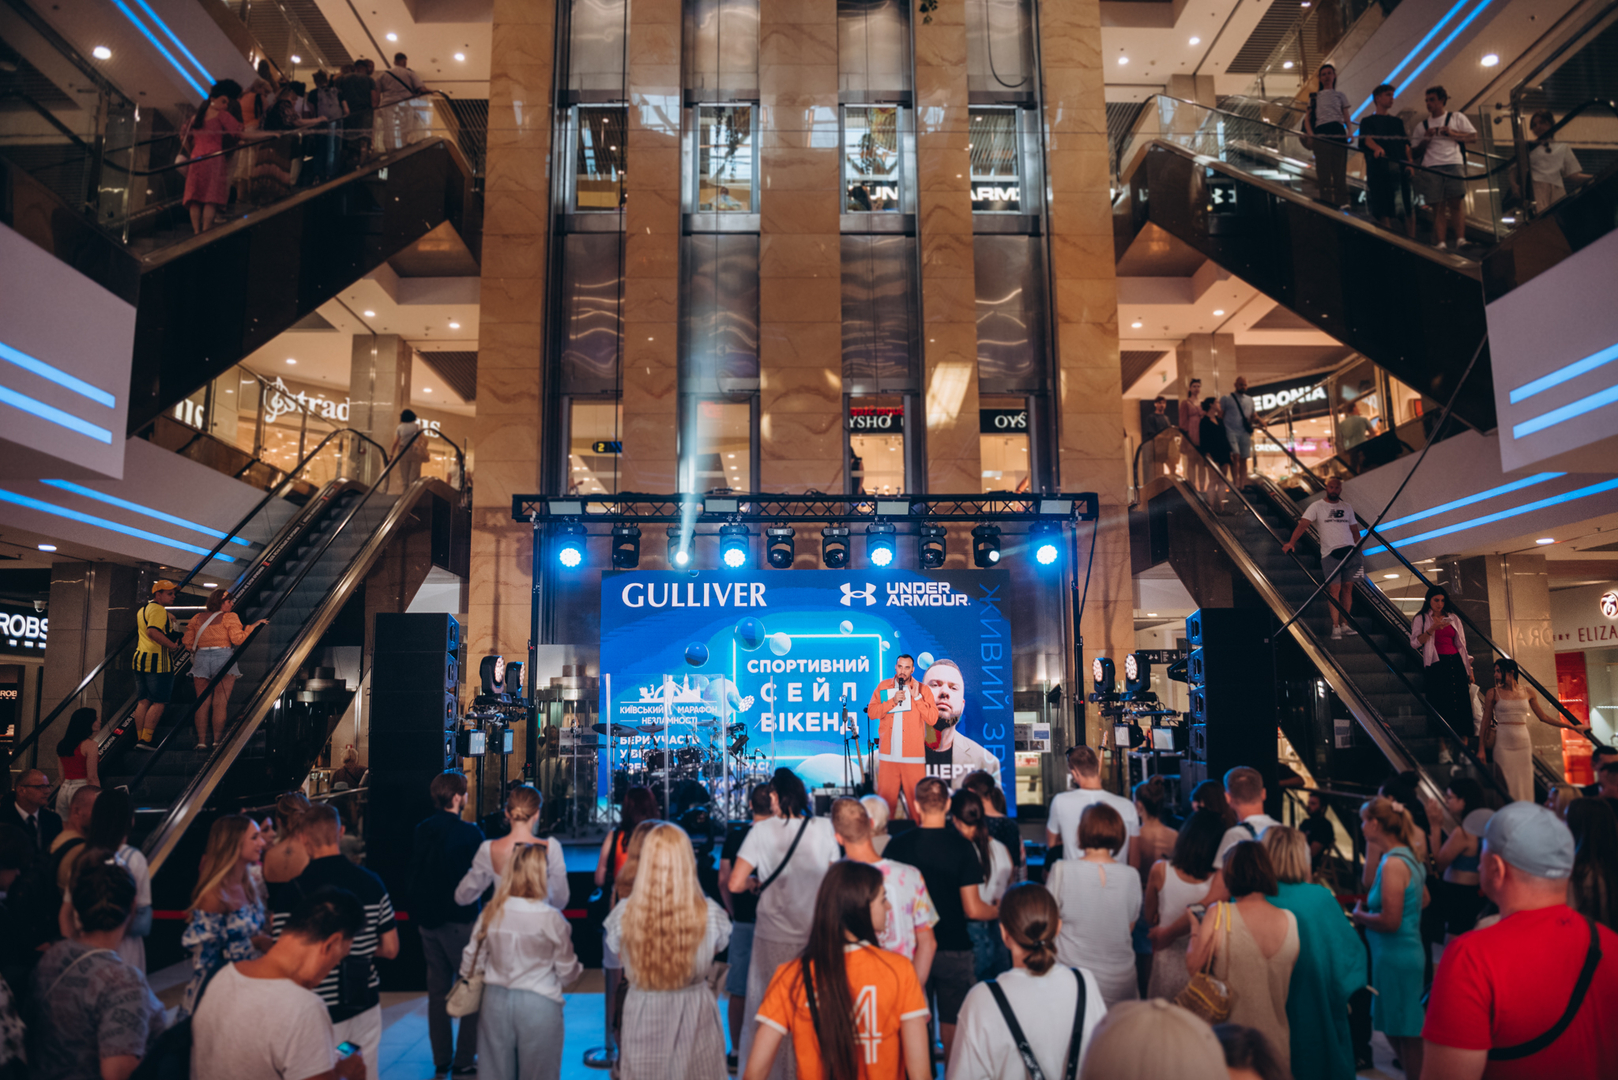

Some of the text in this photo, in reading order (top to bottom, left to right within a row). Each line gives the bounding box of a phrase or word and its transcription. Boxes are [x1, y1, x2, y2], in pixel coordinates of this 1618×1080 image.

[994, 415, 1027, 428] OYS
[622, 582, 767, 607] GULLIVER
[886, 582, 950, 594] UNDER
[979, 583, 1009, 710] ЖИВИЙ
[747, 656, 869, 673] СПОРТИВНИЙ
